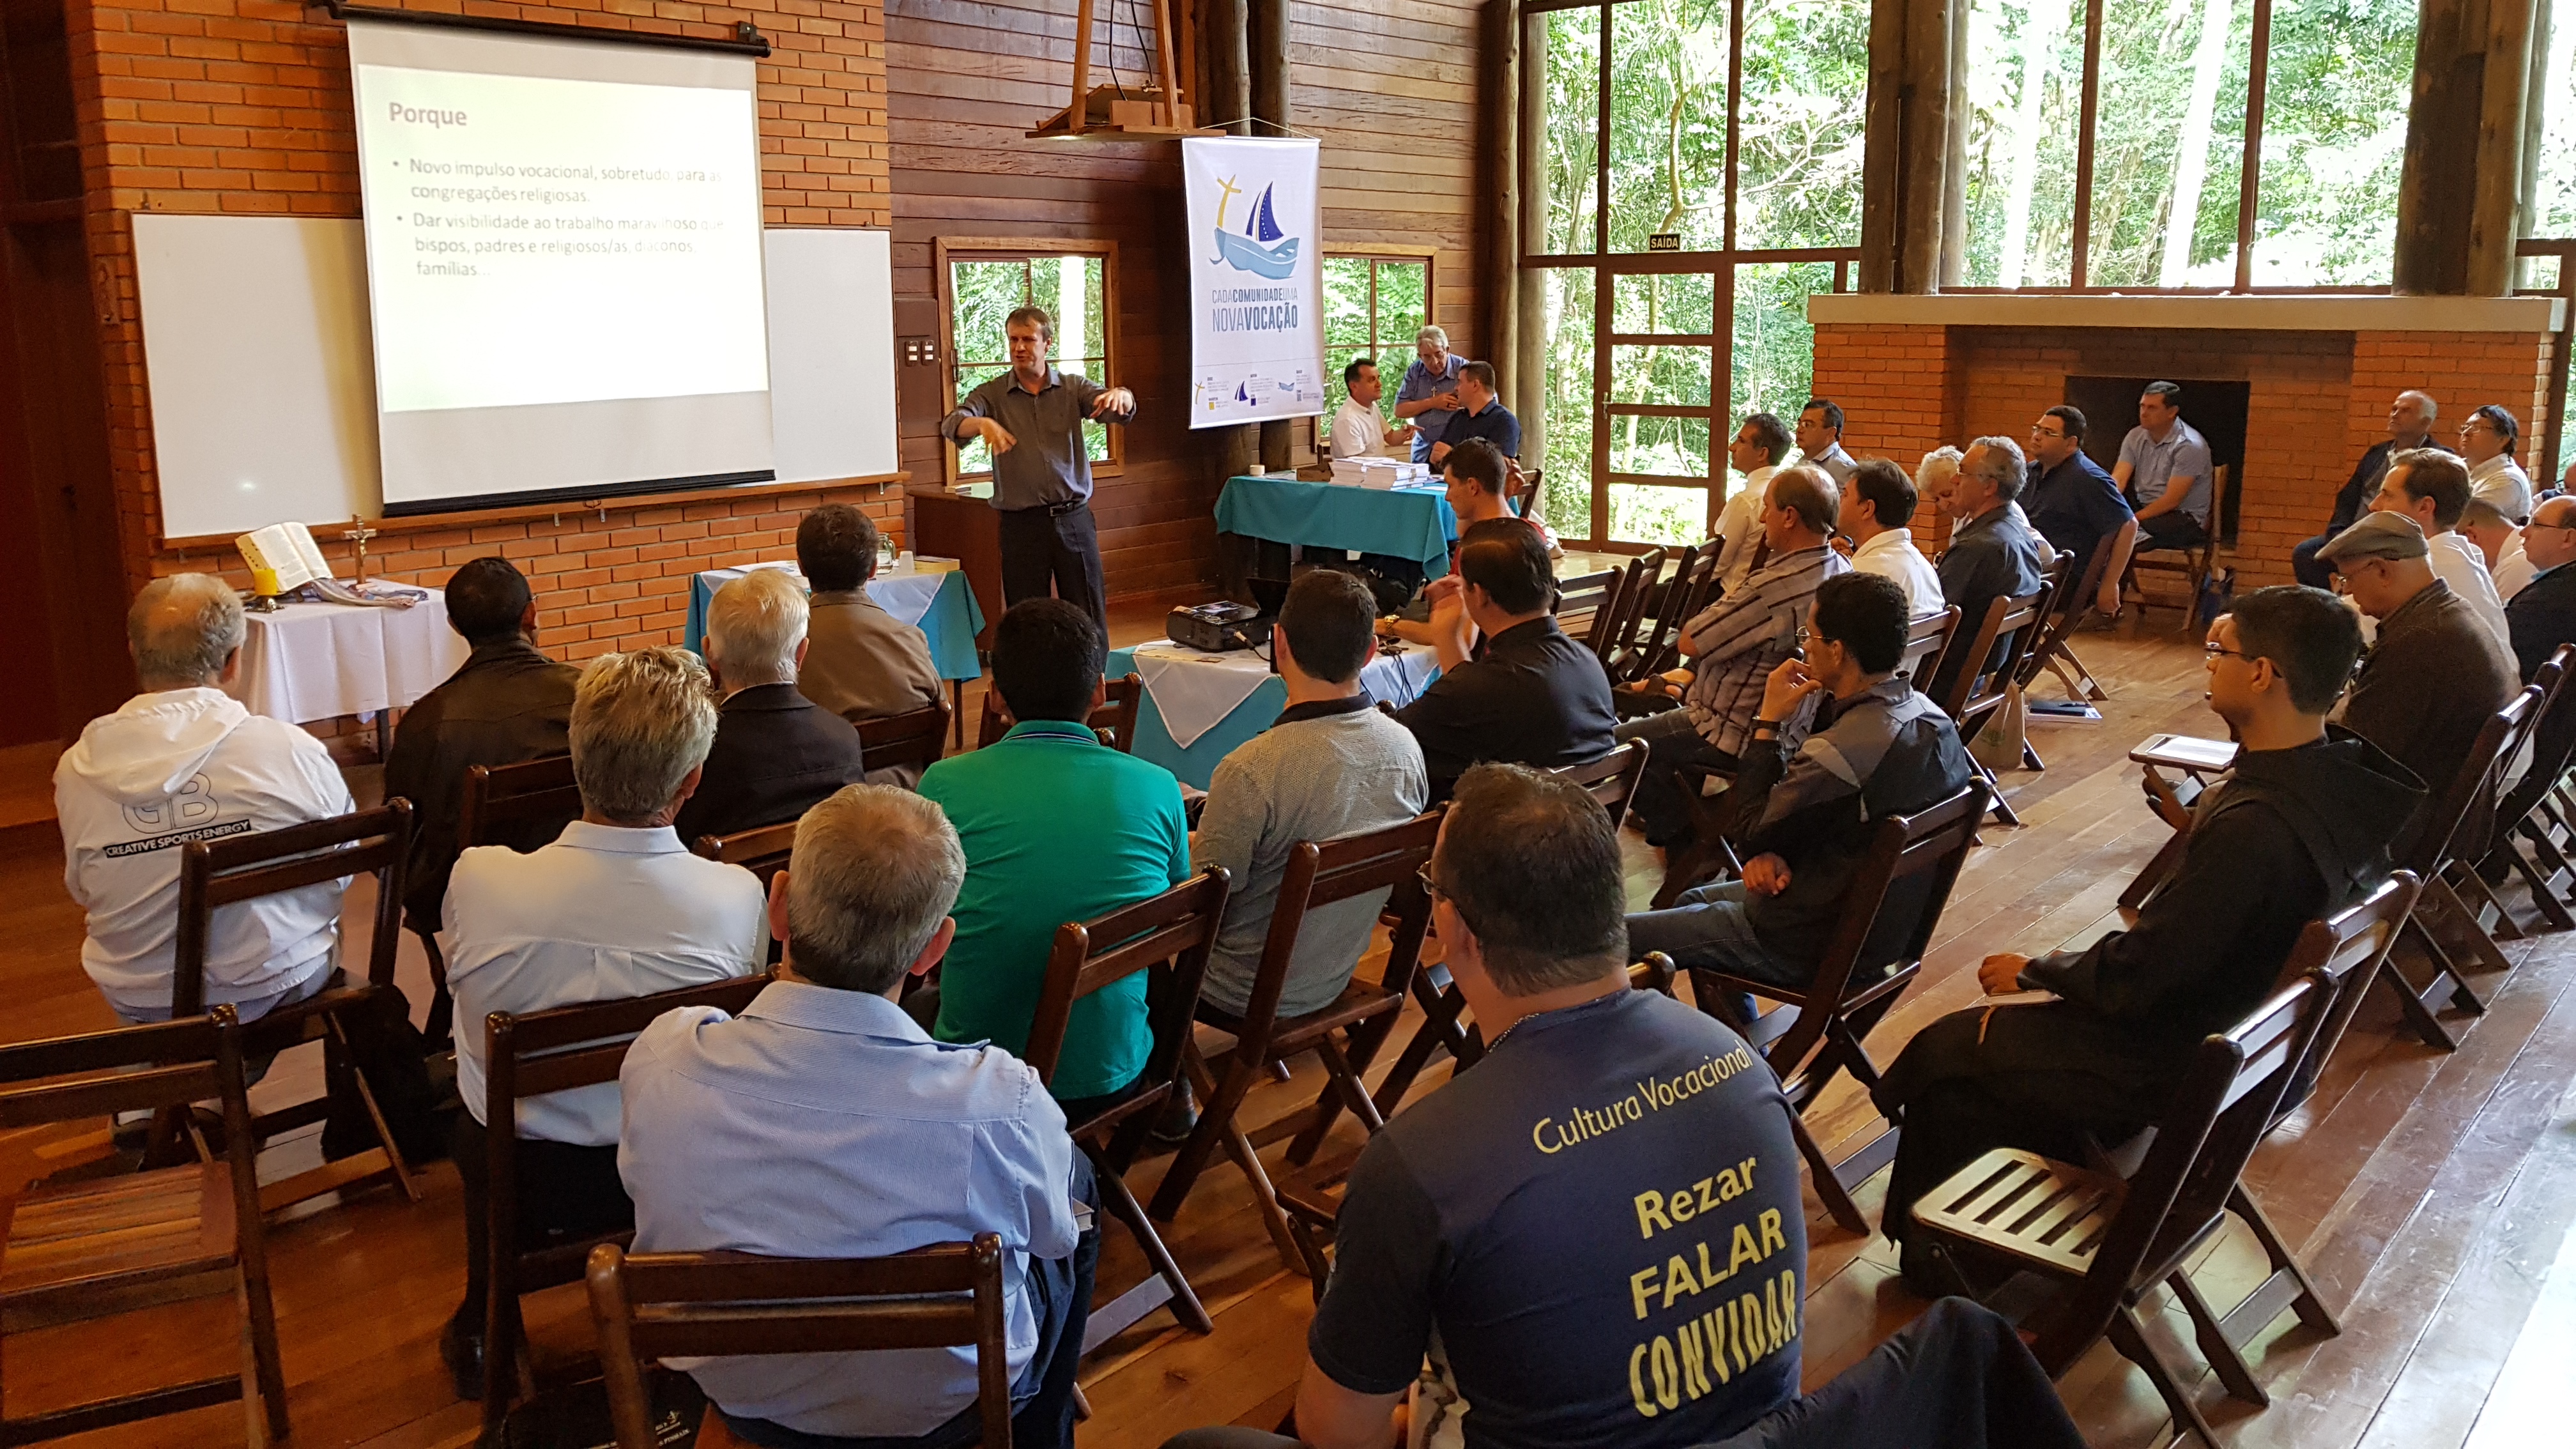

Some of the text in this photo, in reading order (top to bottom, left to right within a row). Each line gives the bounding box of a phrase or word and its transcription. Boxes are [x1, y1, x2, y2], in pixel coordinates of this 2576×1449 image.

[389, 102, 467, 129] Porque
[410, 158, 452, 174] Novo
[455, 160, 515, 178] impulso
[519, 164, 598, 181] vocacional,
[677, 171, 705, 182] para
[709, 171, 722, 182] as
[411, 186, 590, 205] congregações religiosas.
[413, 212, 724, 231] Dar visibilidade ao trabalho maravilhoso que
[415, 237, 470, 254] bispos,
[475, 238, 525, 255] padres
[529, 242, 537, 252] e
[1651, 235, 1678, 249] SAÍDA
[106, 820, 250, 856] CREATIVE SPORTS ENERGY
[1533, 1039, 1754, 1154] Cultura Vocacional
[1633, 1156, 1757, 1239] Rezar
[1629, 1207, 1787, 1321] FALAR
[1629, 1268, 1798, 1418] CONVIDAR
